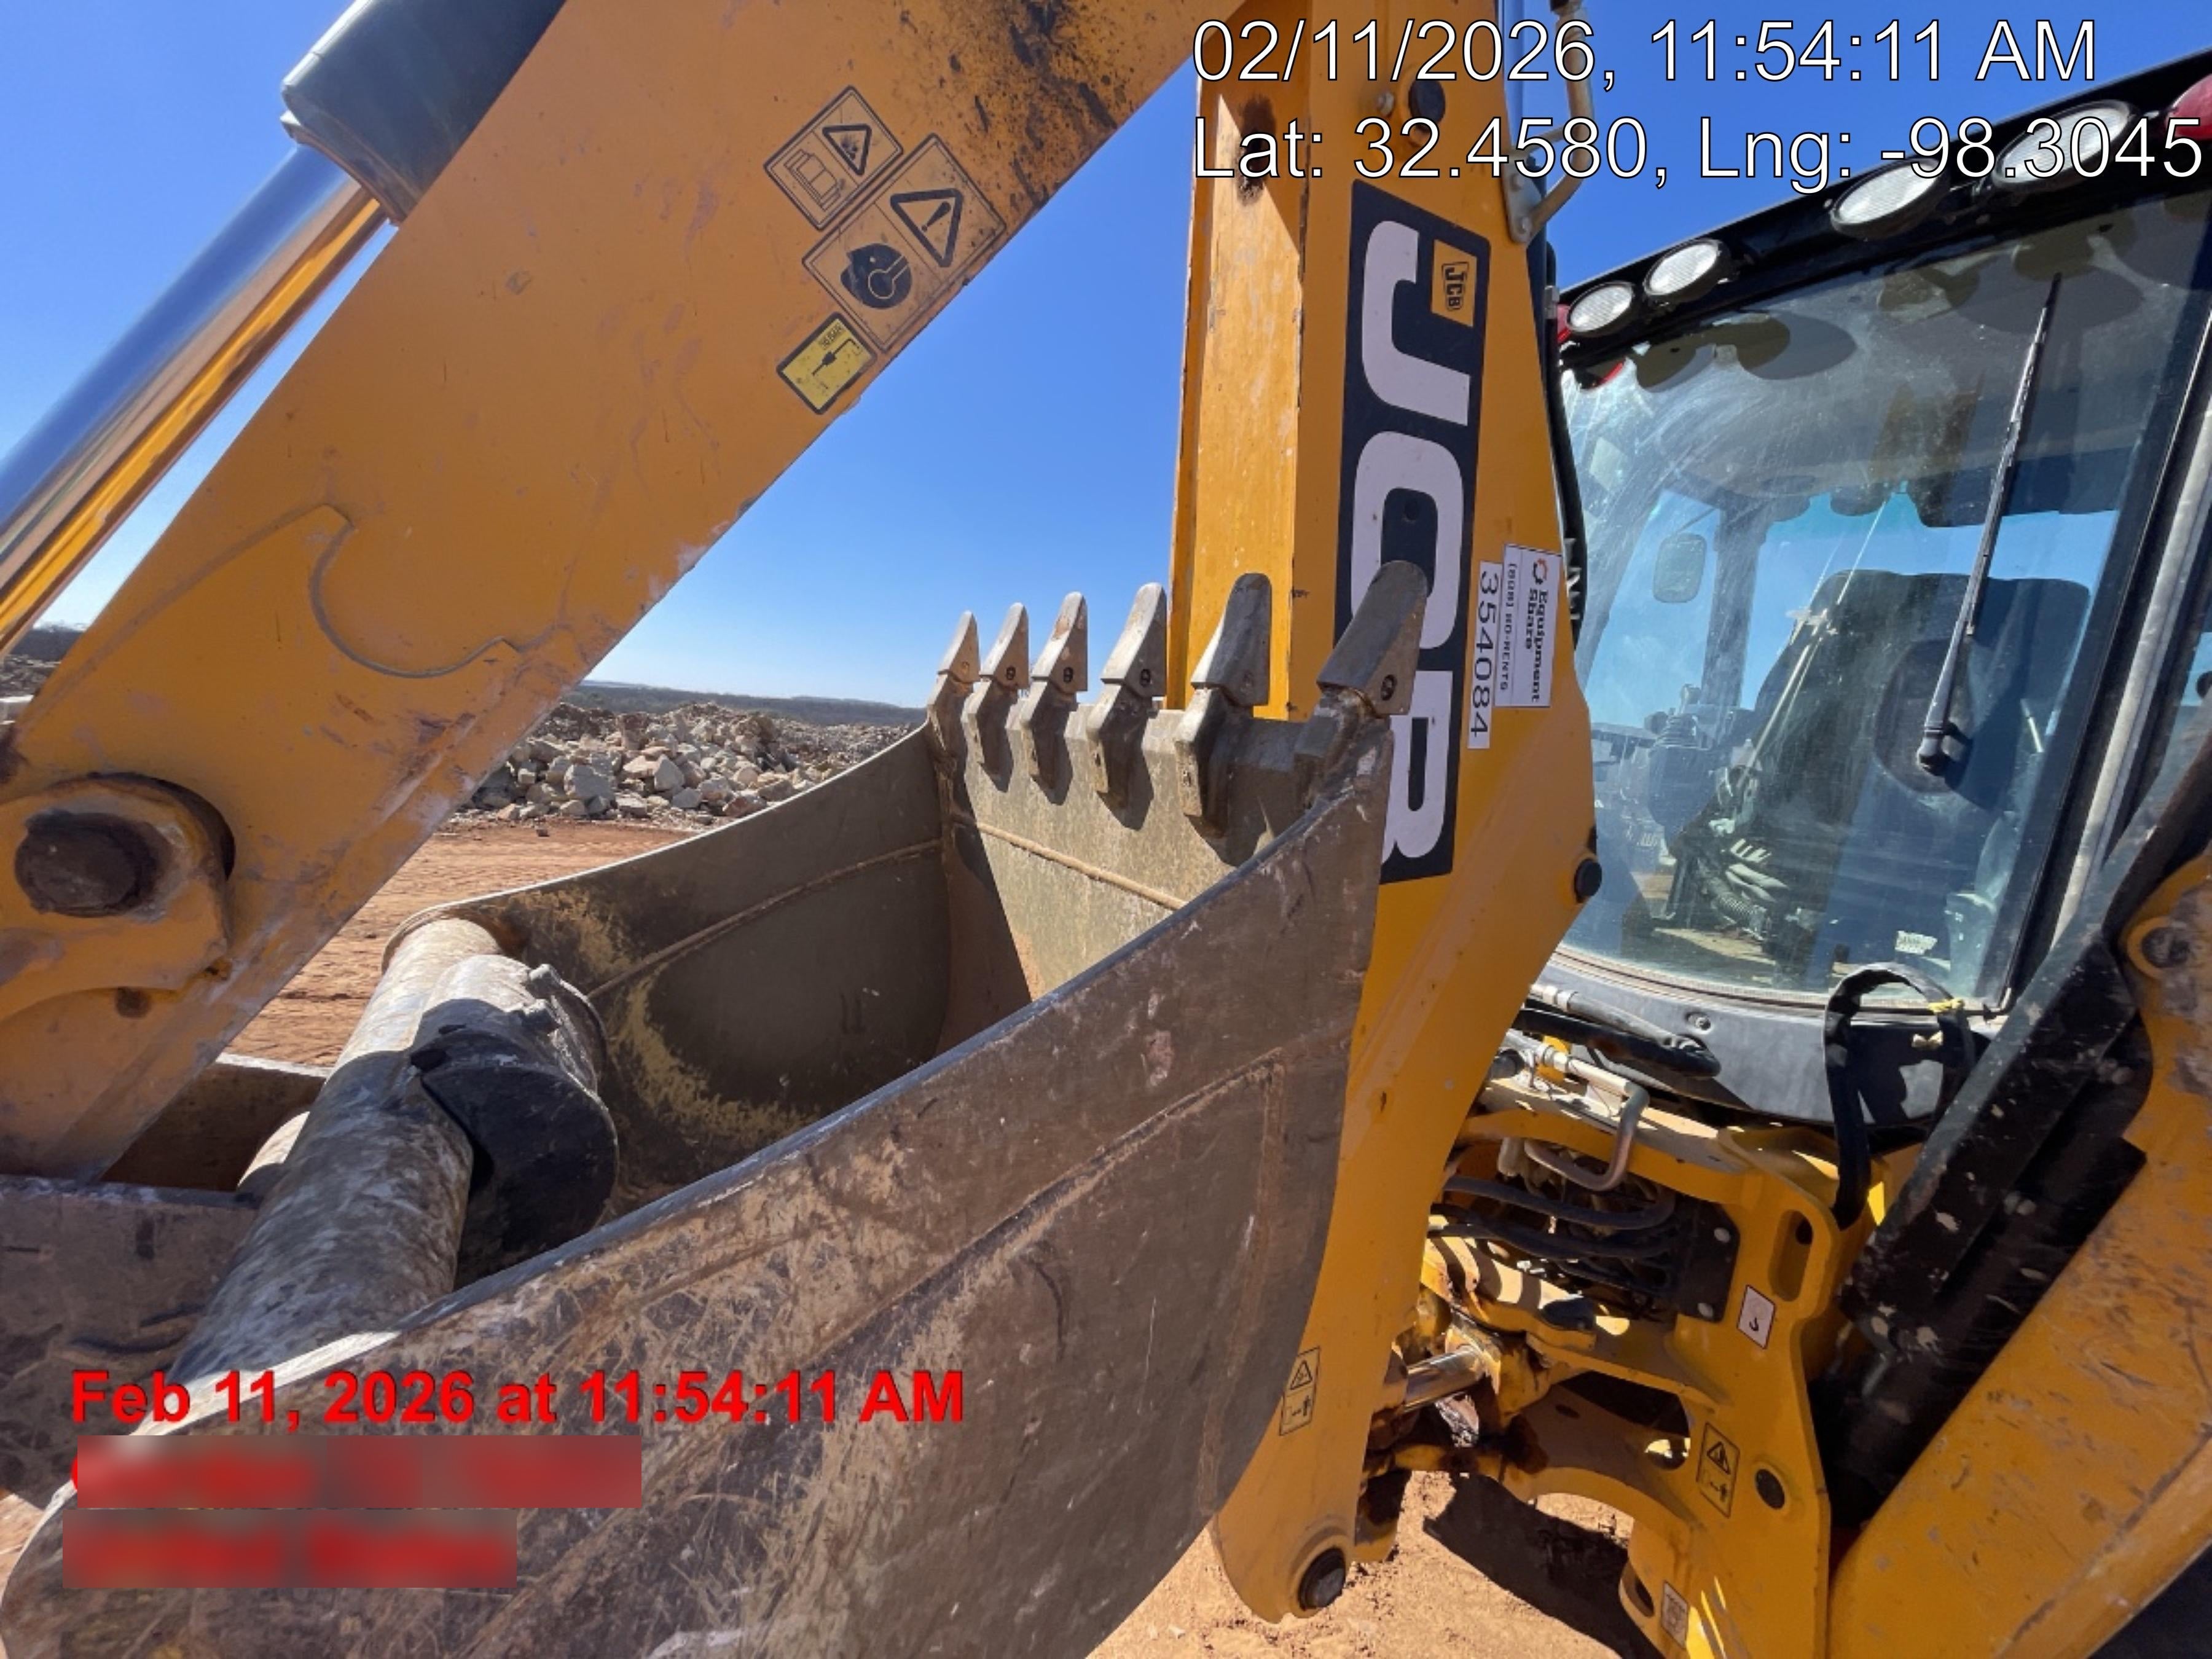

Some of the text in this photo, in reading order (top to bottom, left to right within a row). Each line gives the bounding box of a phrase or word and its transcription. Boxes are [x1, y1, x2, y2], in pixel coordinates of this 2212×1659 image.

[1445, 267, 1467, 307] JCB
[1470, 571, 1499, 738] 354084
[1526, 587, 1538, 650] Share
[1531, 589, 1548, 702] Equipment
